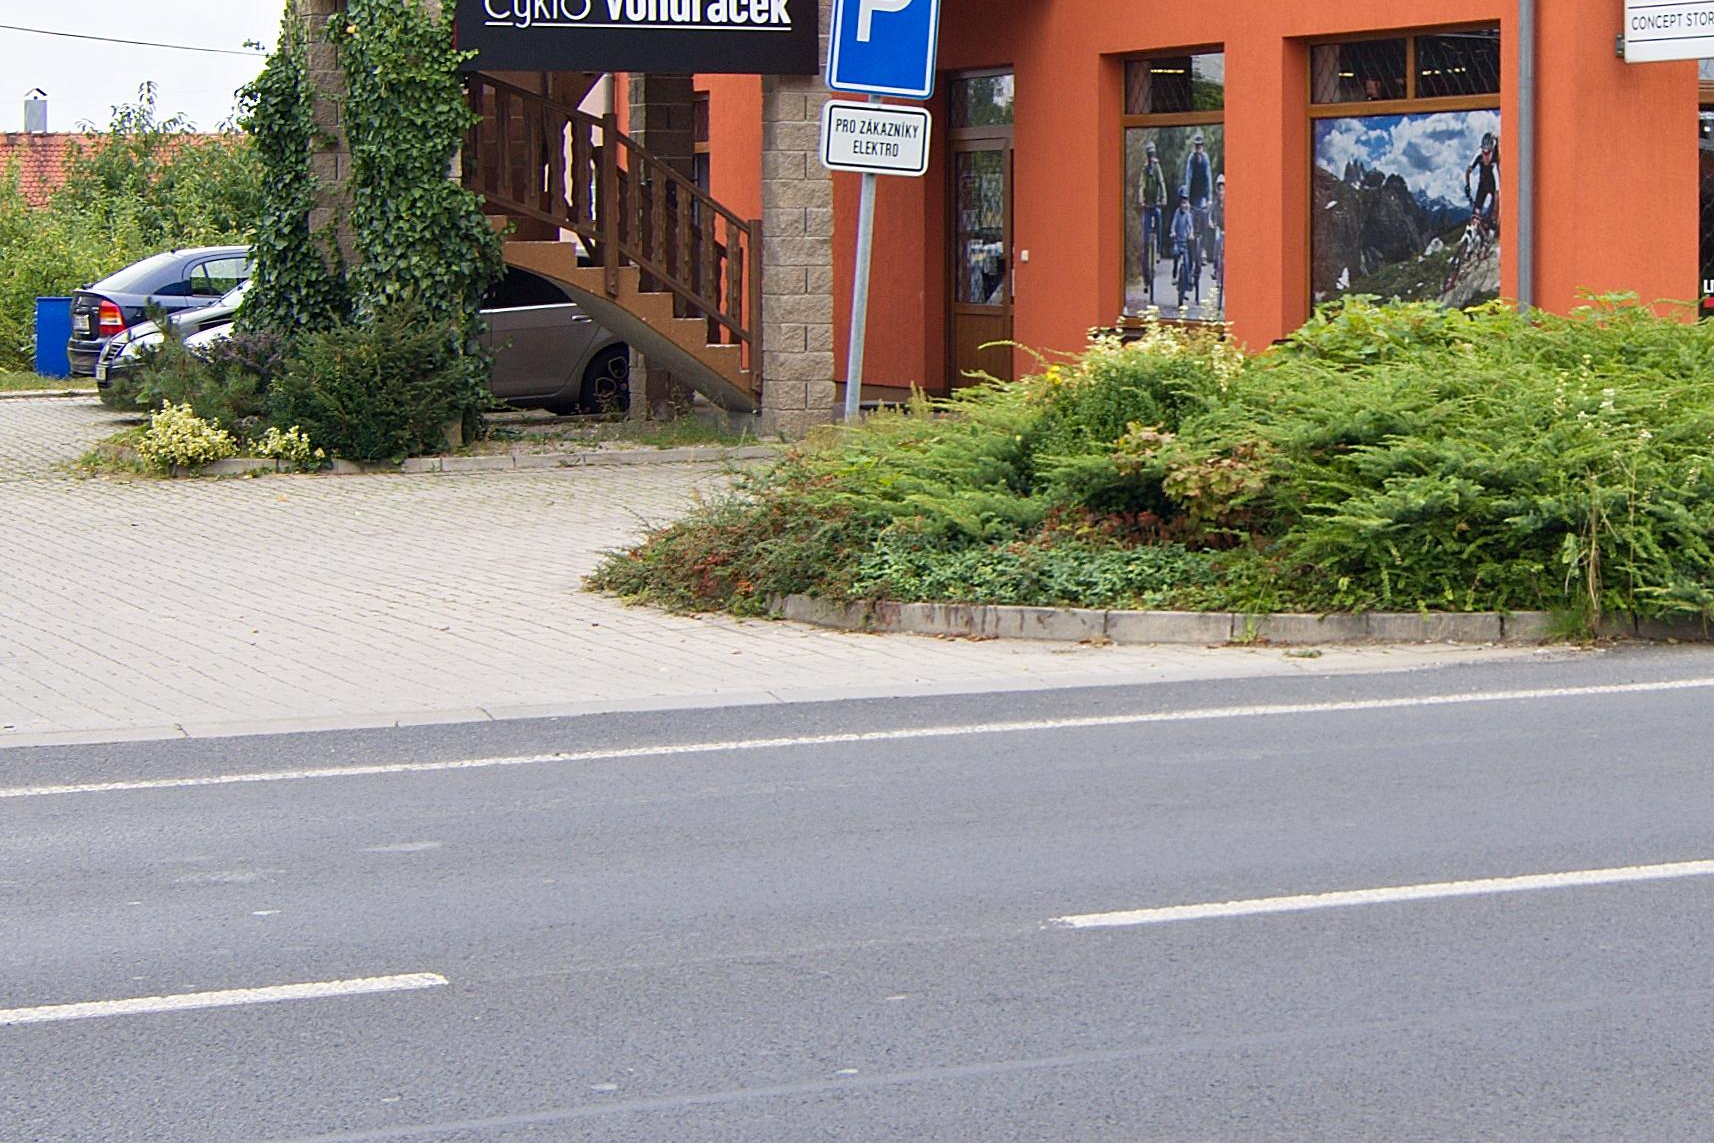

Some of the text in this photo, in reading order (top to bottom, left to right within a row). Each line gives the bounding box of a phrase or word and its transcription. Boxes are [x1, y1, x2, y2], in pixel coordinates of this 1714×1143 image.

[1631, 13, 1683, 31] CONCEPT
[835, 118, 919, 138] PRO ZÁKAZNÍKY
[853, 140, 899, 158] ELEKTRO
